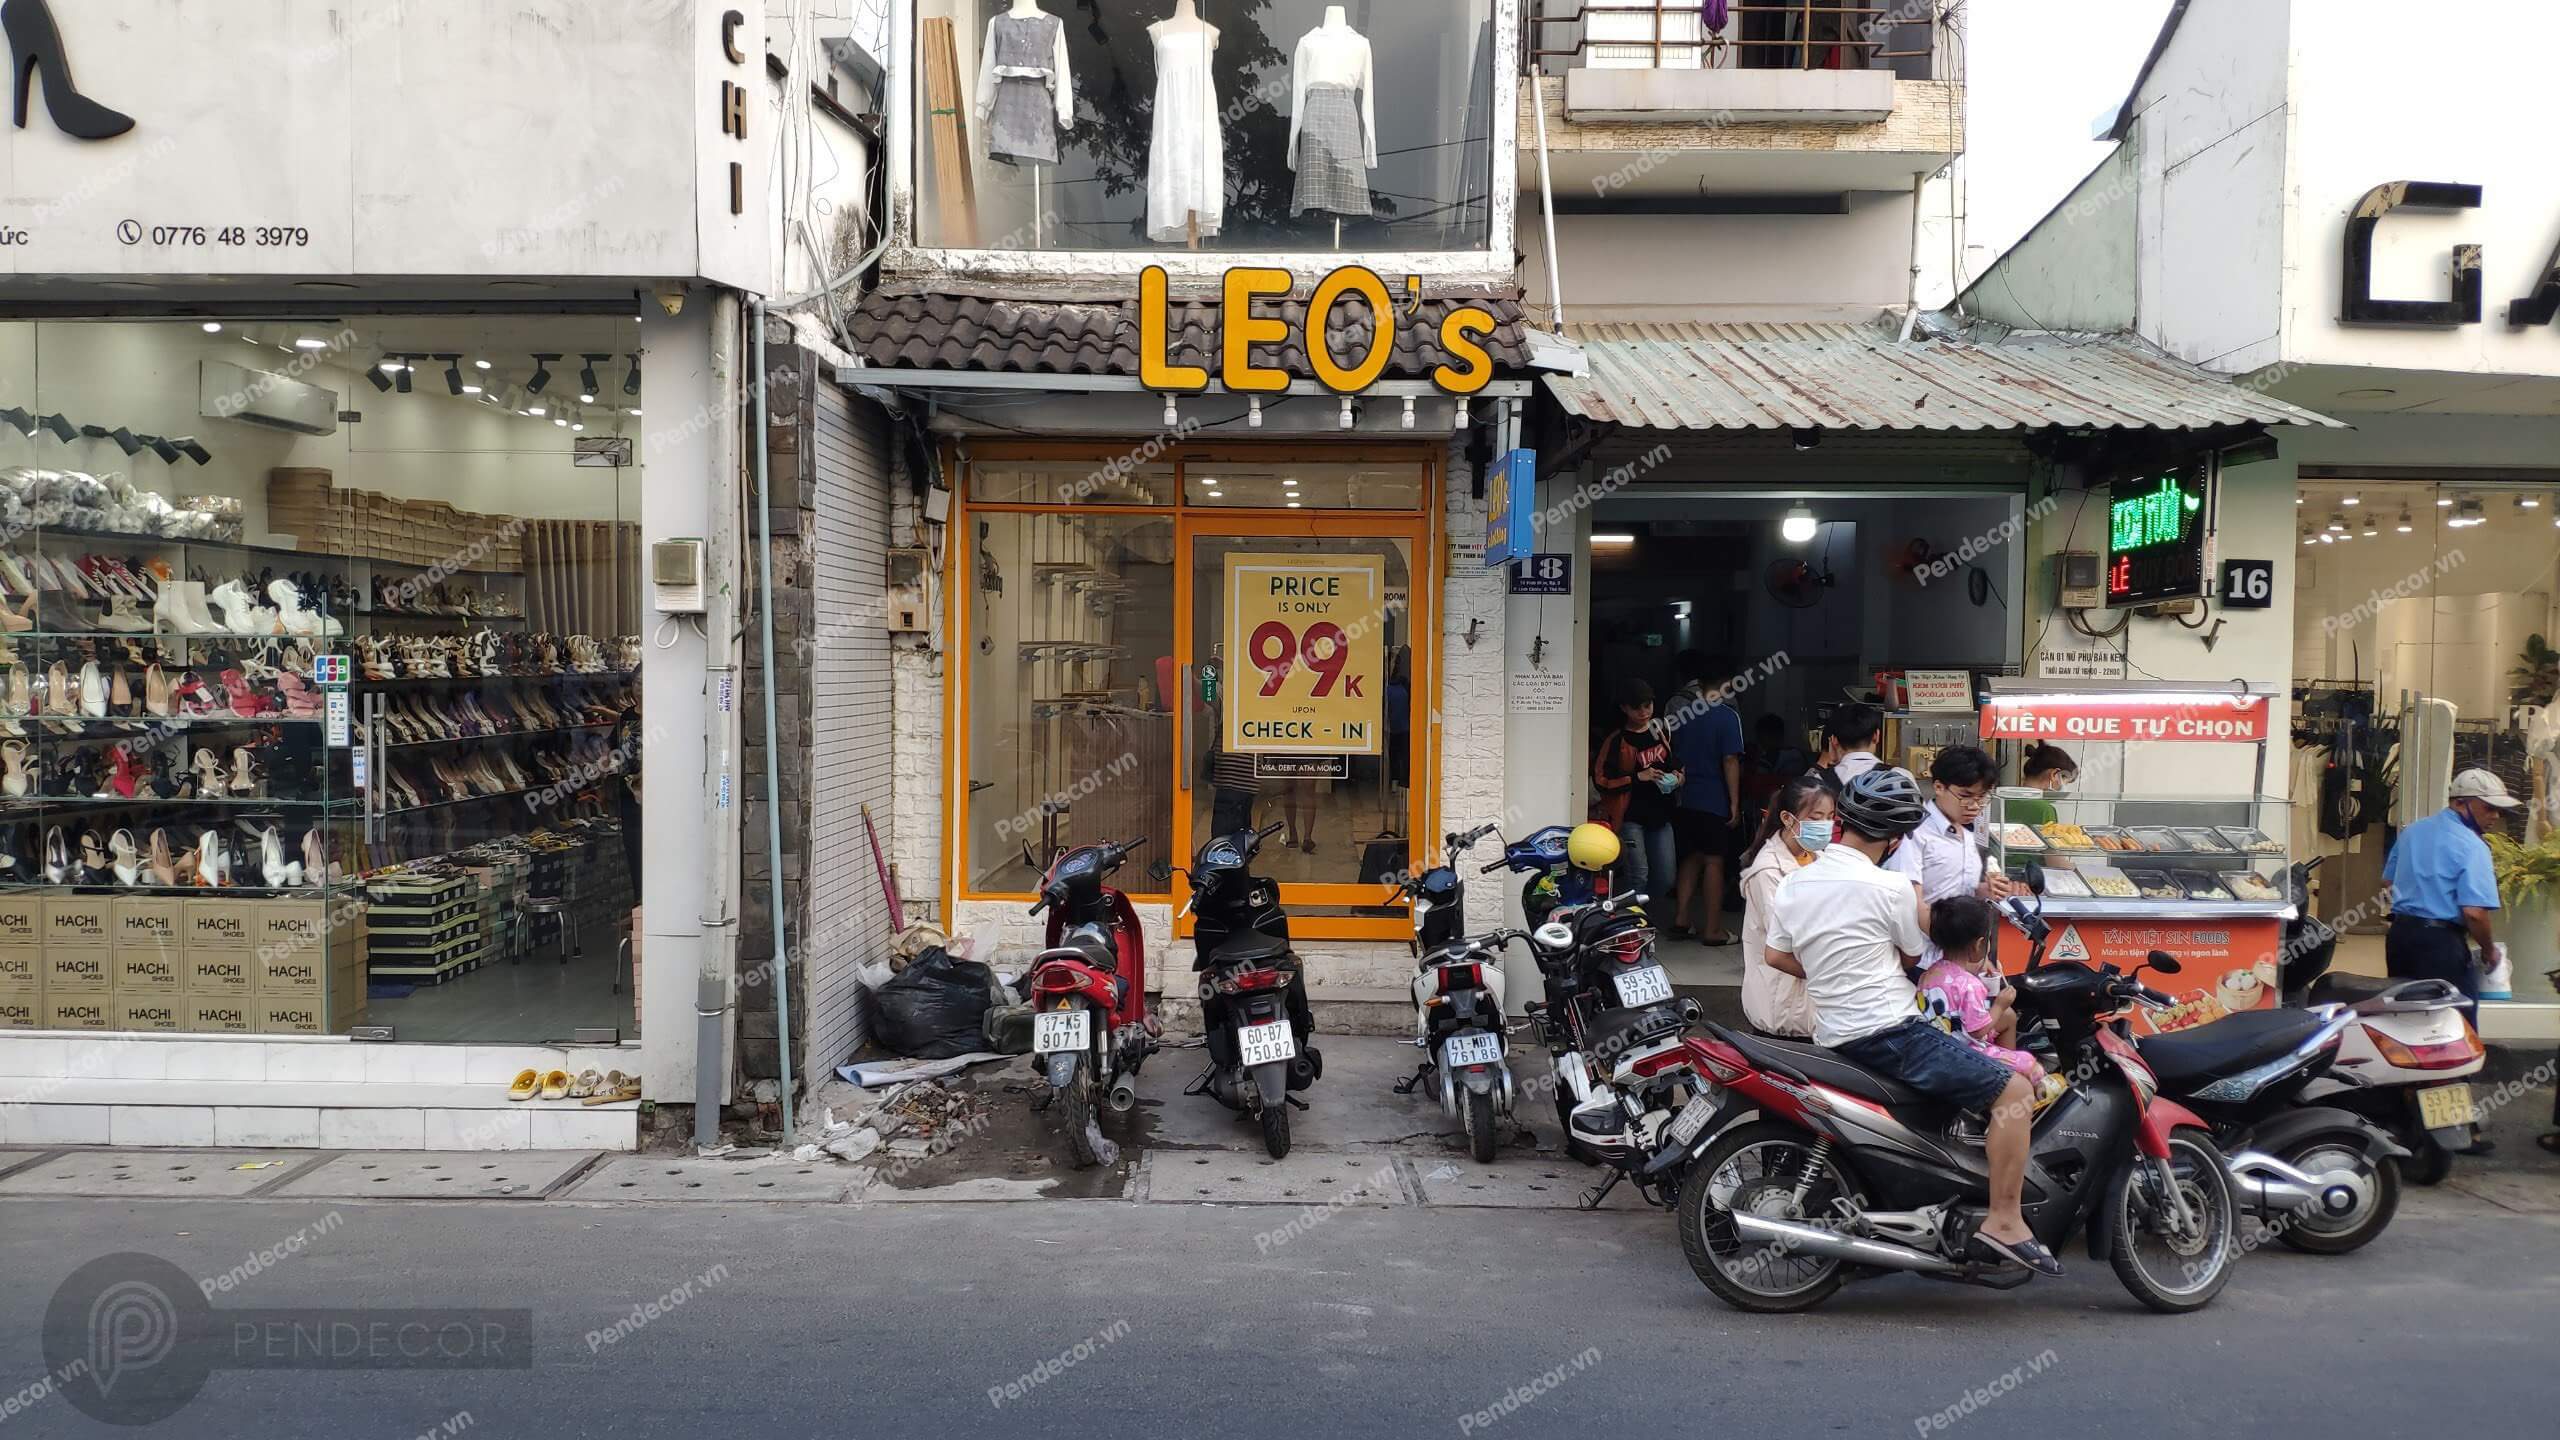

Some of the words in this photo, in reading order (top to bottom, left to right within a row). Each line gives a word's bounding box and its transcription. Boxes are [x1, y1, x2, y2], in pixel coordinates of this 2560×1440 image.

[152, 227, 206, 246] 0776
[217, 227, 245, 246] 48
[255, 227, 308, 246] 3979
[1139, 265, 1497, 394] LEO's
[1516, 558, 1564, 579] 18
[1271, 577, 1339, 596] PRICE
[2229, 568, 2268, 599] 16
[1384, 592, 1406, 600] ROOM
[1278, 603, 1288, 613] IS
[1295, 602, 1330, 613] ONLY
[1242, 722, 1313, 738] CHECK
[1342, 723, 1363, 738] IN
[1993, 713, 2057, 732] XIÊN
[2067, 715, 2121, 734] QUE
[2131, 716, 2169, 736] TỰ
[2178, 718, 2253, 738] CHỌN
[56, 915, 97, 927] HACHI
[126, 917, 168, 929] HACHI
[197, 919, 240, 930] HACHI
[269, 920, 310, 931] HACHI
[2103, 928, 2131, 945] TÂN
[2134, 929, 2164, 946] VIỆT
[2166, 931, 2191, 945] SIN
[2192, 931, 2230, 945] FOODS
[2060, 944, 2081, 953] TVS
[56, 962, 98, 973] HACHI
[127, 963, 169, 975] HACHI
[198, 964, 240, 976] HACHI
[269, 966, 311, 977] HACHI
[1622, 970, 1658, 990] 59-S1
[1624, 984, 1669, 1005] 272.04
[58, 1007, 99, 1018] HACHI
[129, 1009, 171, 1020] HACHI
[199, 1010, 241, 1021] HACHI
[270, 1011, 312, 1022] HACHI
[1043, 1031, 1080, 1048] 9071
[1248, 1024, 1281, 1044] 60-B7
[1245, 1041, 1291, 1063] 750.82
[1452, 1048, 1497, 1064] 761.86
[2058, 1130, 2099, 1139] HONDA
